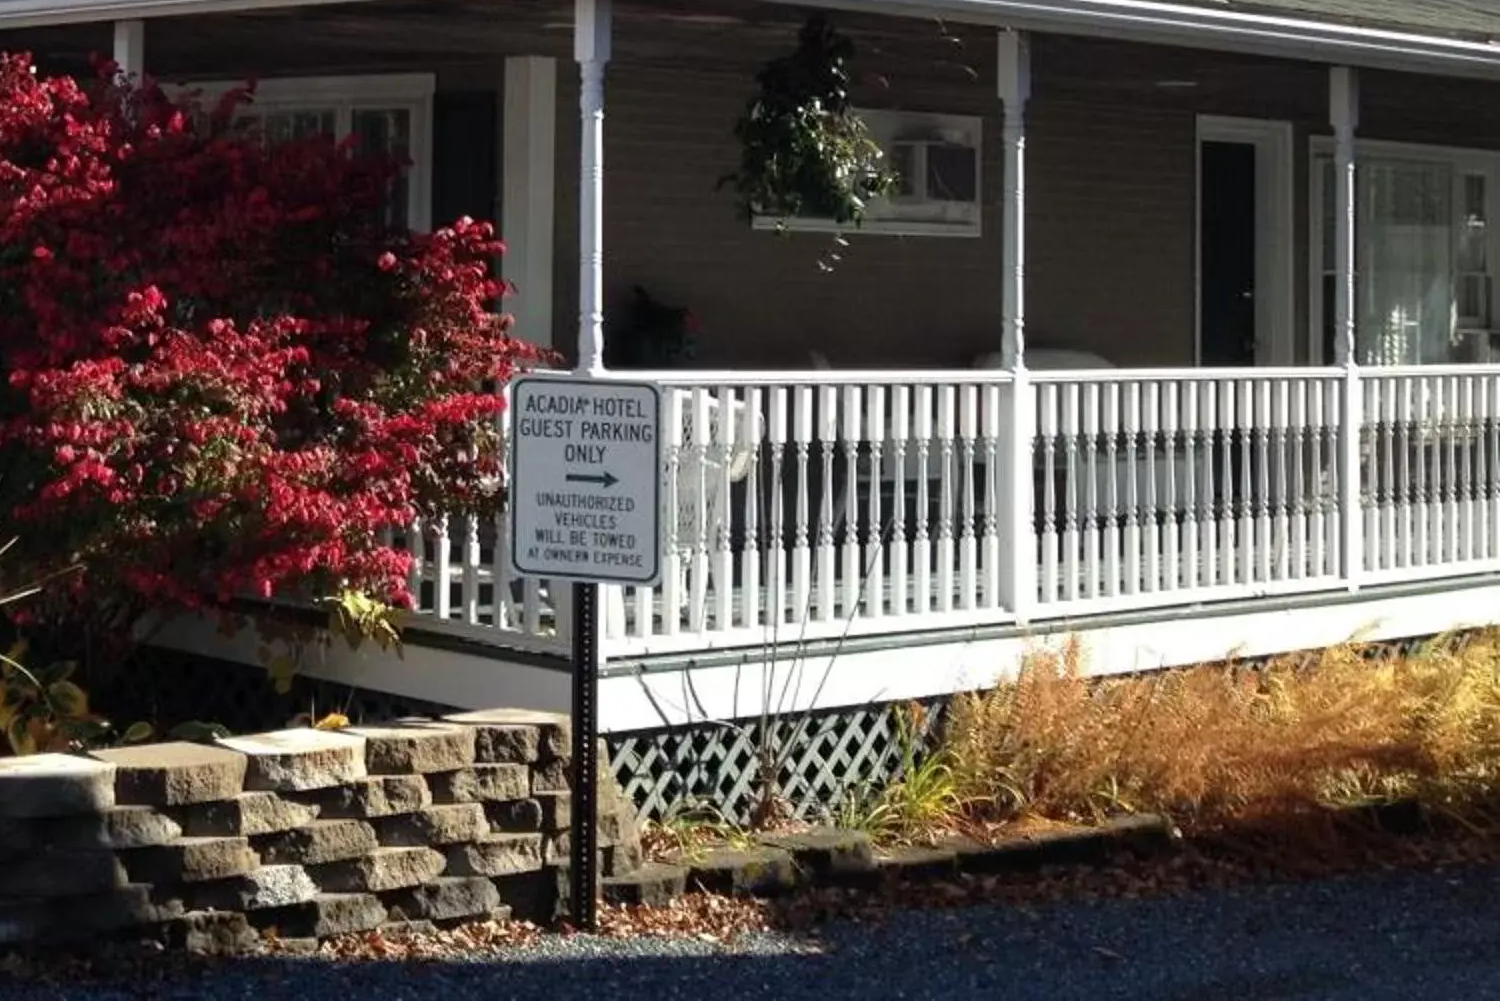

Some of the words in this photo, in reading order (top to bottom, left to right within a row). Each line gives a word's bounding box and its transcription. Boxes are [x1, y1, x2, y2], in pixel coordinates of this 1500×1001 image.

[593, 397, 647, 418] HOTEL
[520, 419, 572, 439] GUEST
[581, 421, 652, 442] PARKING
[564, 444, 606, 464] ONLY
[536, 492, 635, 512] UNAUTHORIZED
[554, 511, 617, 530] VEHICLES
[535, 528, 564, 544] WILL
[569, 530, 587, 546] BE
[593, 532, 635, 549] TOWED
[528, 548, 539, 559] AT
[593, 552, 644, 567] EXPENSE
